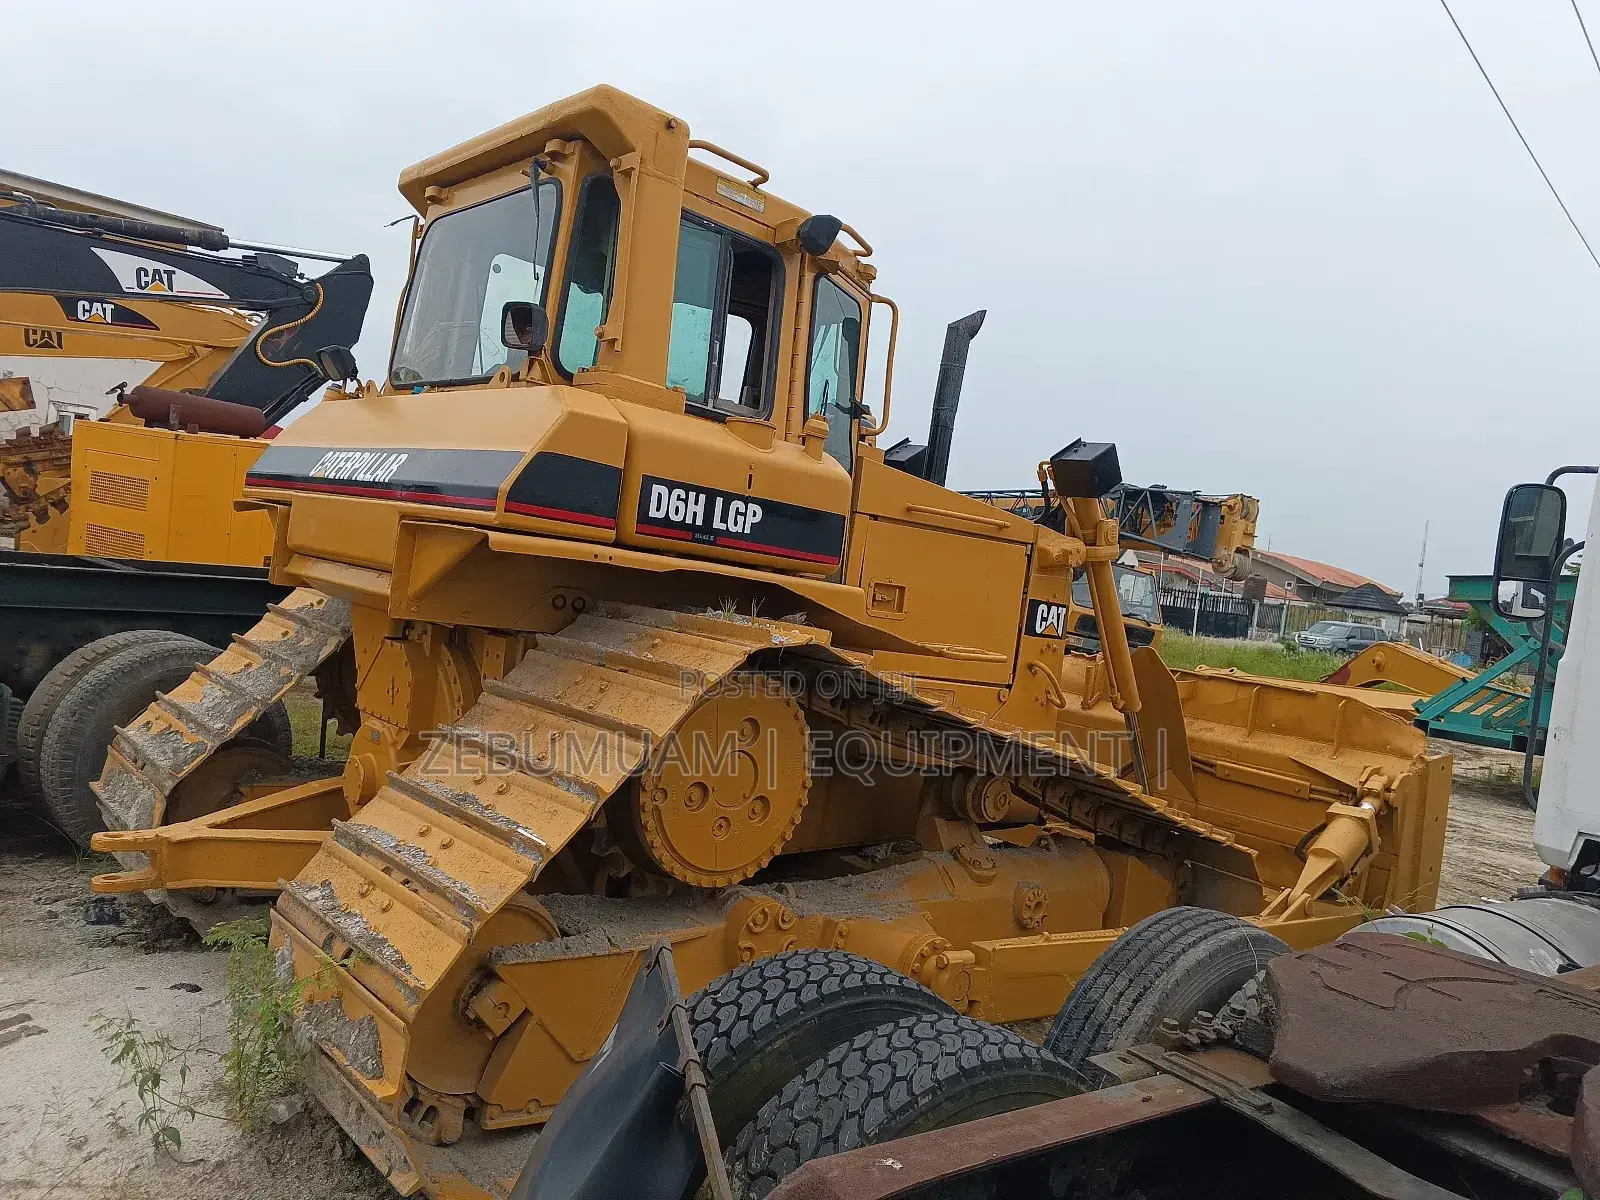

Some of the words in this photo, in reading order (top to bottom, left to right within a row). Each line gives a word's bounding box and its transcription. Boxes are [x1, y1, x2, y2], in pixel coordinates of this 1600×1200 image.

[135, 267, 176, 292] CAT
[77, 300, 115, 324] CAT
[24, 328, 63, 350] CAT
[309, 451, 408, 483] CATERPILLAR
[649, 483, 706, 526] D6H
[713, 496, 763, 534] LGP
[1035, 603, 1067, 637] CAT
